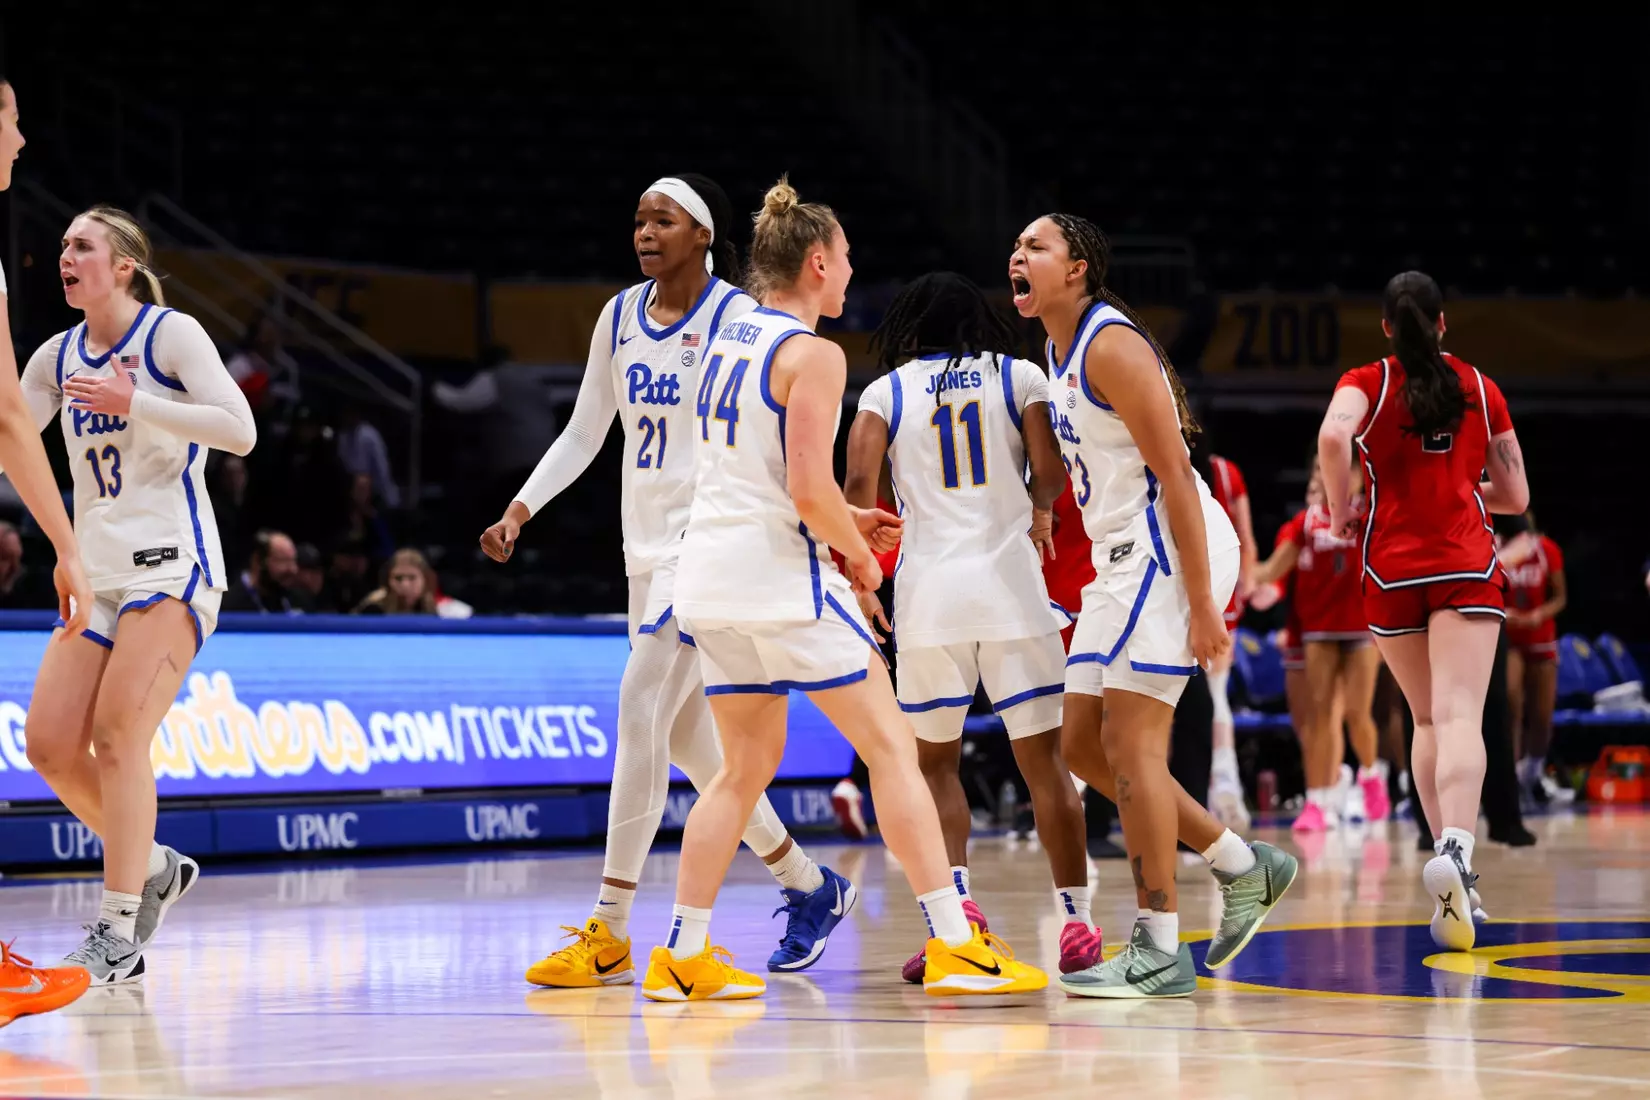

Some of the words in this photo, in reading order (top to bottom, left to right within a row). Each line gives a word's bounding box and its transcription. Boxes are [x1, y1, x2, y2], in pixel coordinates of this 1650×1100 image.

[1235, 302, 1340, 367] ZOO
[626, 362, 681, 406] Pitt
[697, 352, 752, 449] 44
[925, 370, 982, 395] JONES
[636, 415, 667, 471] 21
[930, 399, 988, 490] 11
[85, 444, 122, 499] 13
[277, 812, 359, 851] UPMC
[464, 803, 541, 841] UPMC
